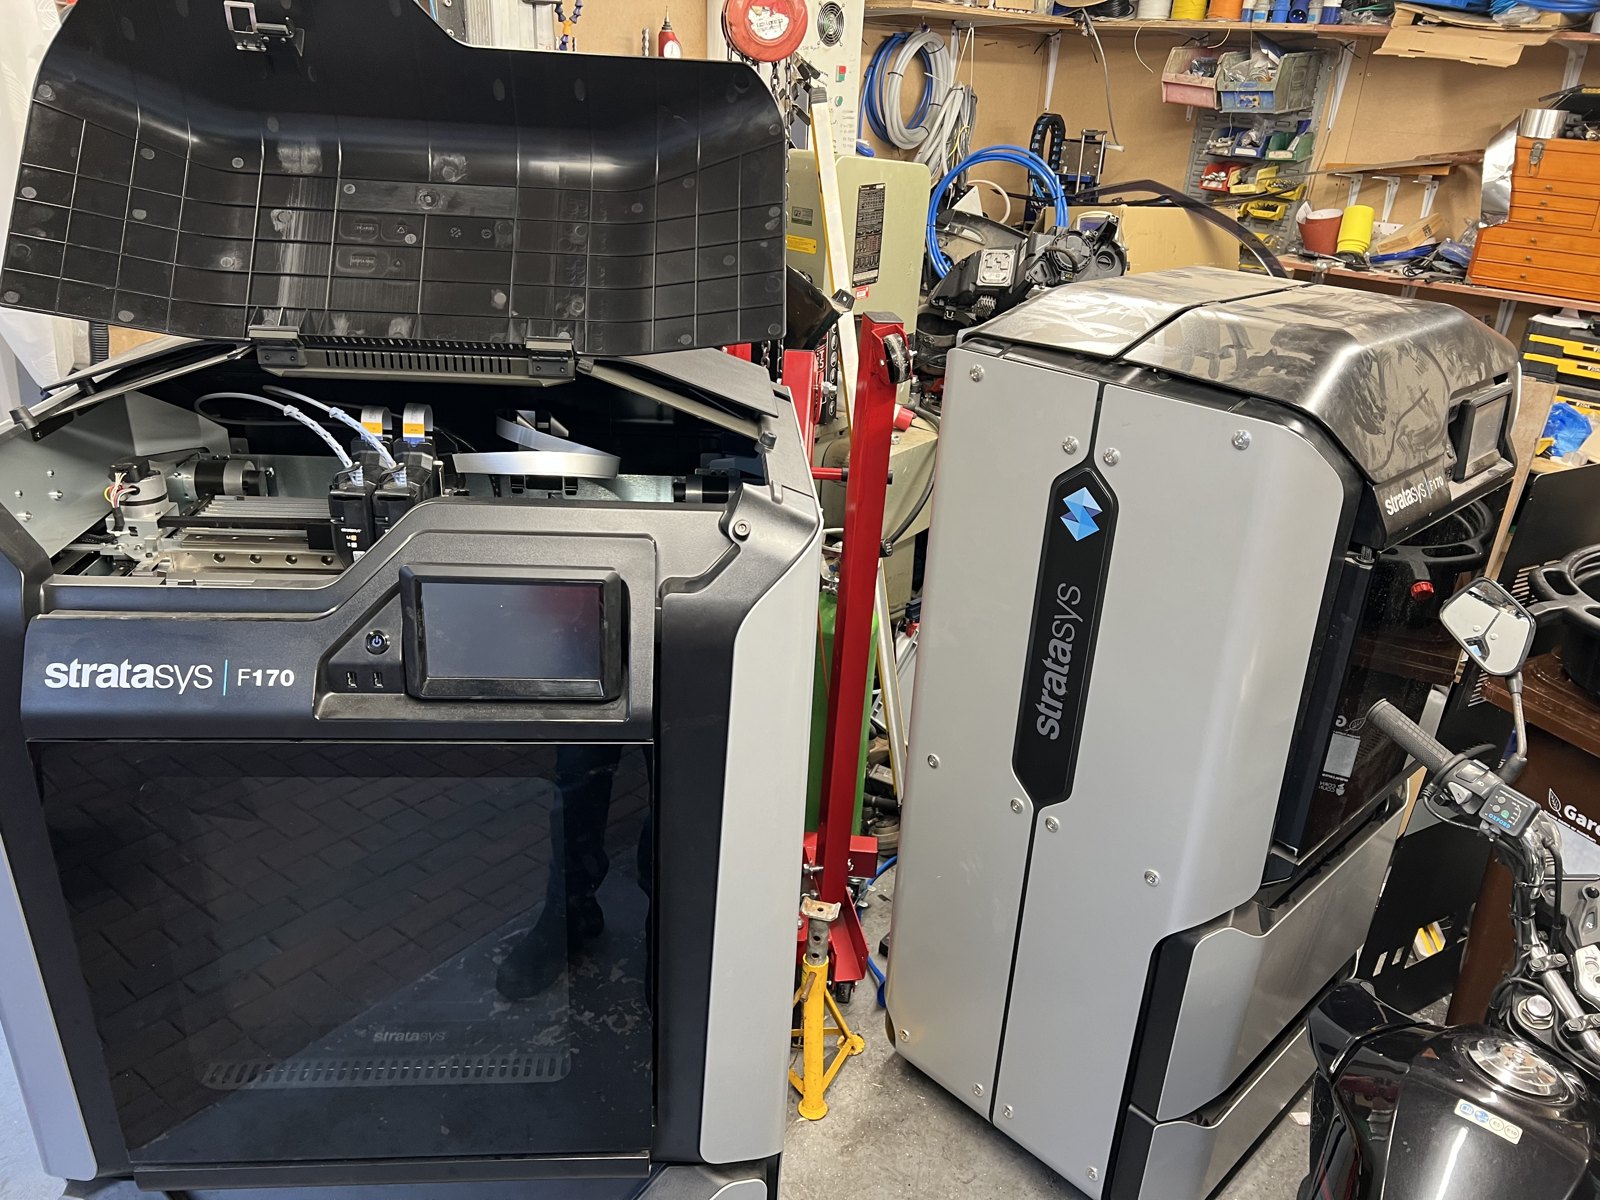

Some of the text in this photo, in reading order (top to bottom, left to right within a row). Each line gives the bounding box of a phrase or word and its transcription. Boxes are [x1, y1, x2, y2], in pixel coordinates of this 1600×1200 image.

[1384, 475, 1444, 515] stratasys F170
[44, 658, 295, 695] stratasys F170
[1035, 582, 1083, 740] stratasys
[1488, 813, 1511, 829] OXFORD
[373, 1031, 448, 1044] stratasys
